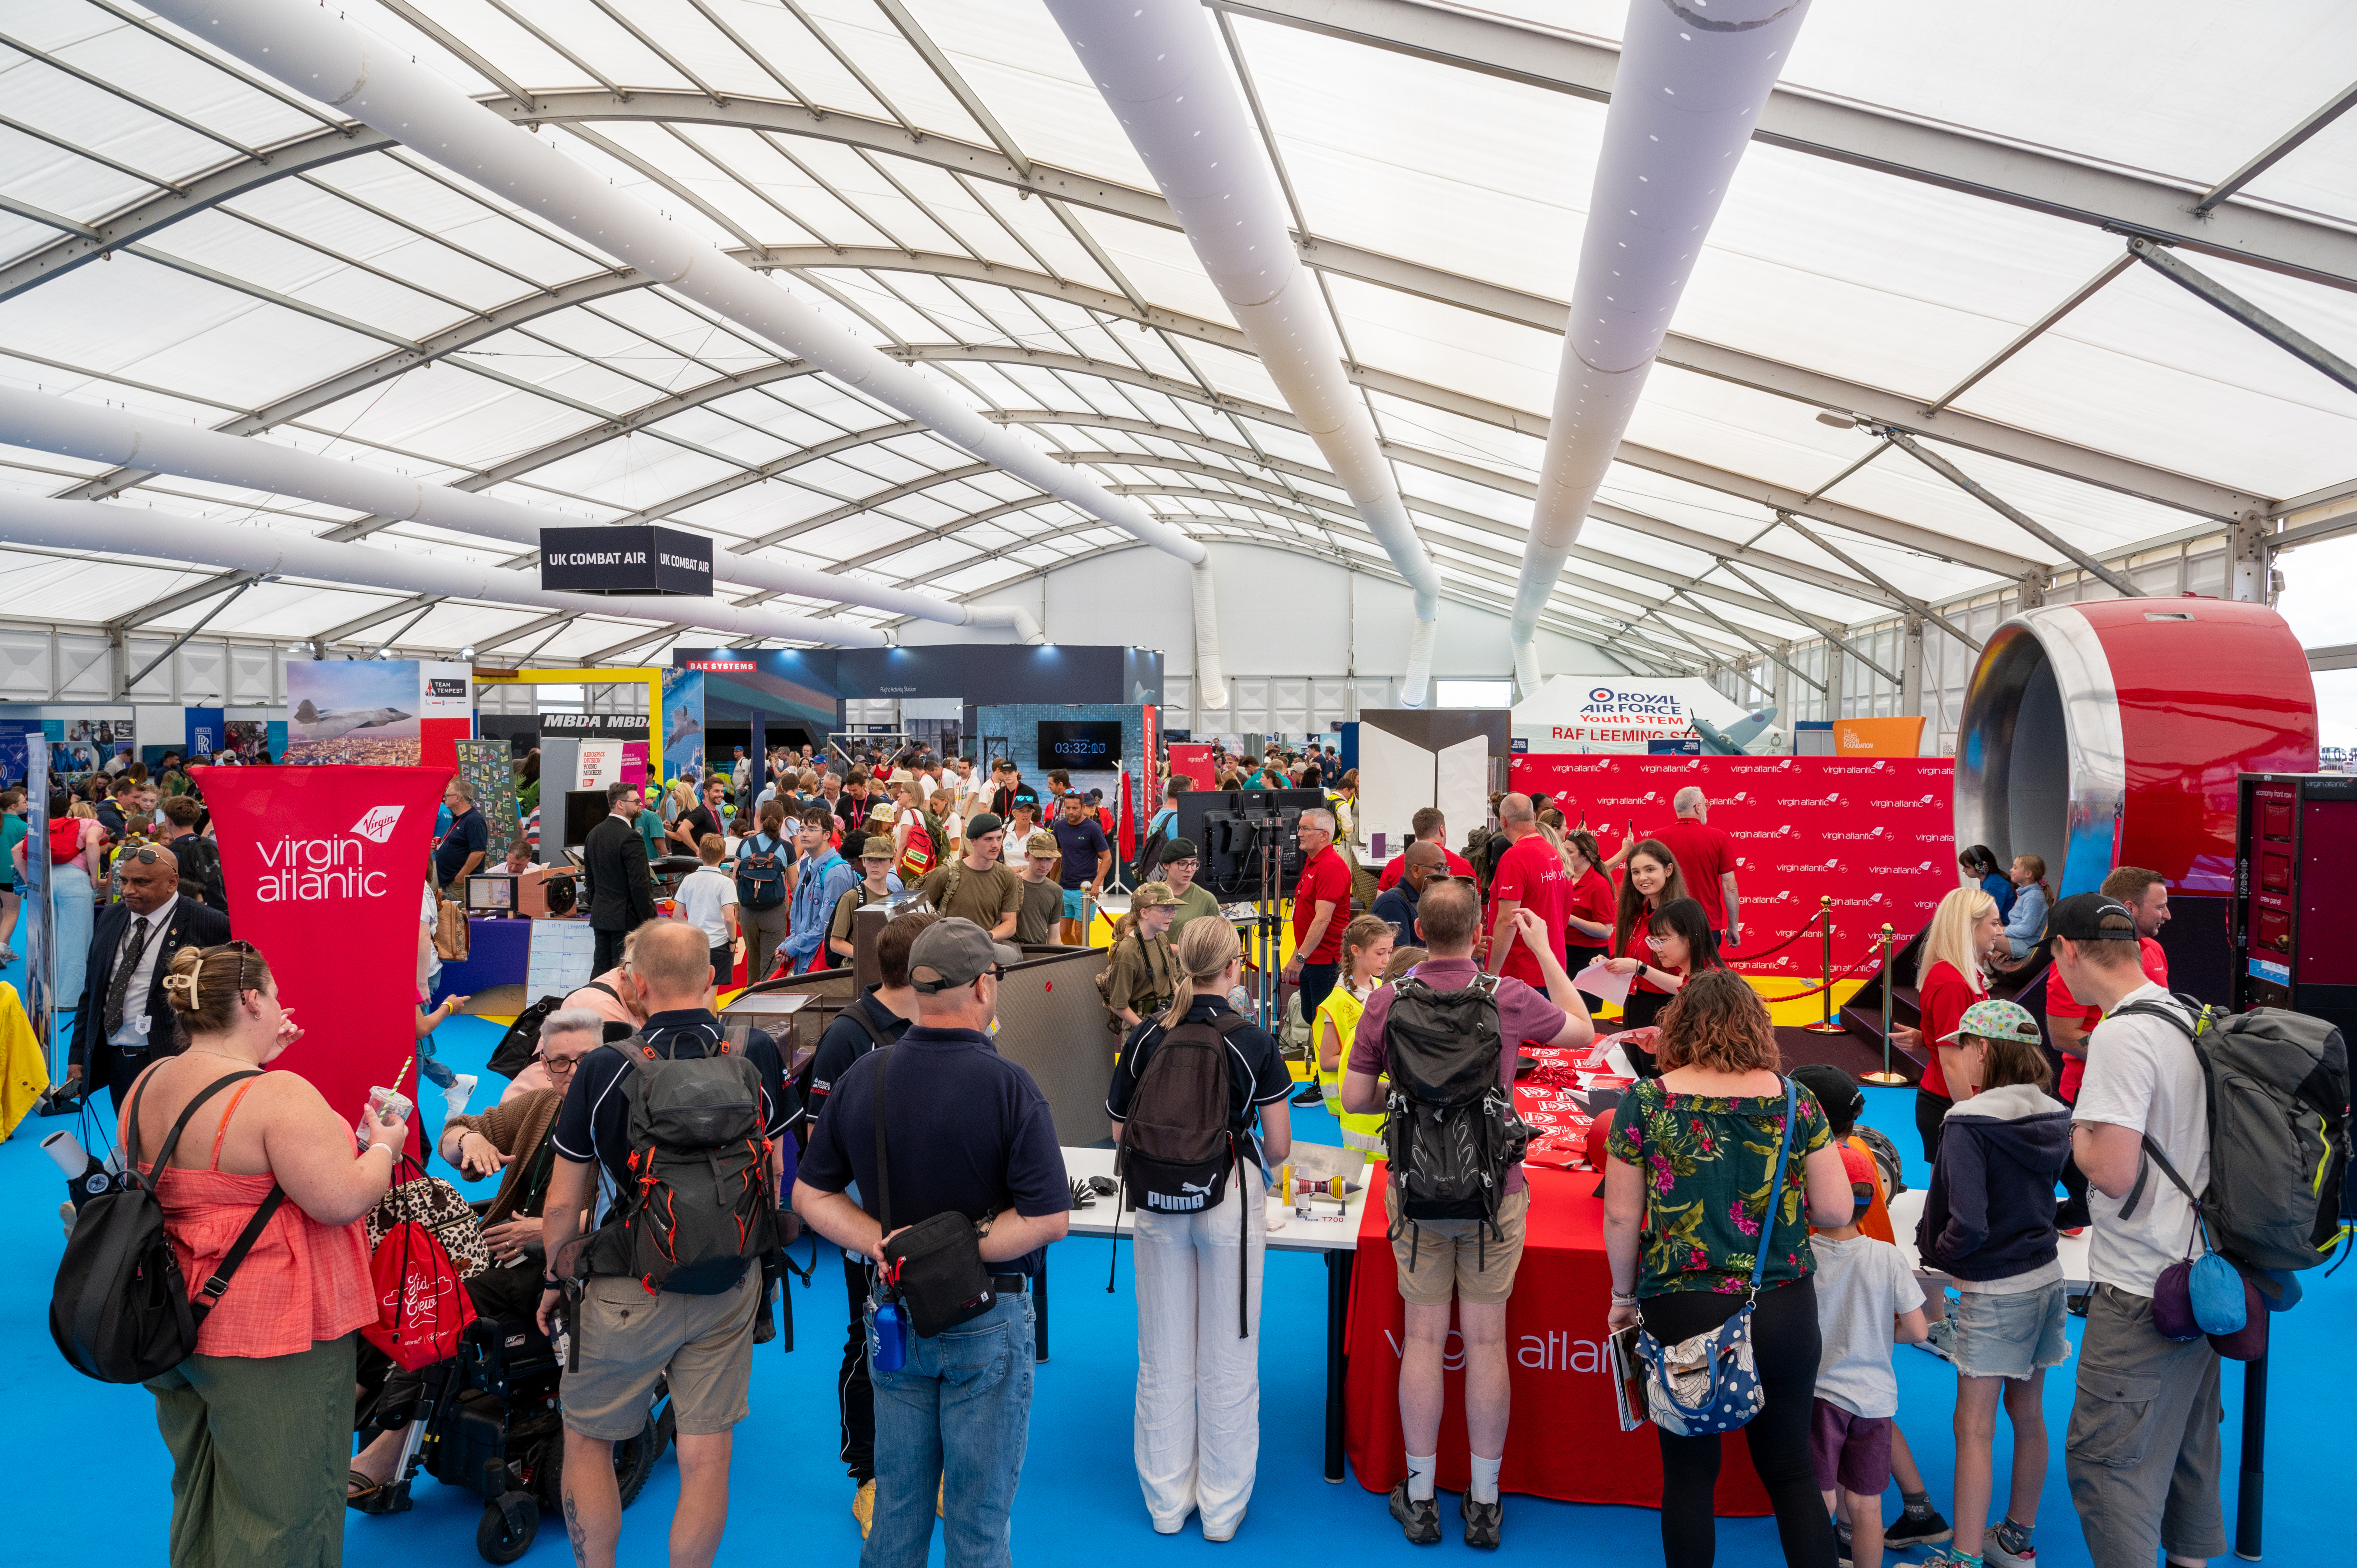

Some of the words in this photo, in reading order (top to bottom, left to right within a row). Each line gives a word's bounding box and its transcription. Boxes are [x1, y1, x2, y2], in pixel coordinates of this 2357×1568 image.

[549, 554, 567, 565] UK
[570, 553, 621, 565] COMBAT
[624, 552, 647, 564] AIR
[660, 553, 670, 566] UK
[671, 555, 698, 570] COMBAT
[698, 561, 709, 573] AIR
[1618, 693, 1680, 705] ROYAL
[1580, 704, 1615, 713] AIR
[1618, 703, 1682, 715] FORCE
[544, 715, 601, 727] MBDA
[1580, 714, 1630, 723] Youth
[1635, 715, 1684, 725] STEM
[1552, 727, 1585, 740] RAF
[1590, 729, 1664, 742] LEEMING
[1552, 765, 1573, 773] virgin
[1640, 765, 1662, 773] virgin
[1730, 765, 1753, 774] virgin
[1823, 766, 1845, 775] virgin
[1917, 767, 1940, 775] virgin
[1597, 797, 1618, 806] virgin
[1777, 798, 1800, 807] virgin
[1870, 799, 1893, 808] virgin
[363, 809, 396, 837] Virgin
[1730, 831, 1752, 839] virgin
[1822, 832, 1844, 841] virgin
[1915, 834, 1938, 842] virgin
[256, 834, 362, 872] virgin
[1776, 864, 1799, 872] virgin
[1869, 867, 1892, 875] virgin
[1541, 869, 1557, 883] Hello
[256, 867, 387, 902] atlantic
[1914, 901, 1937, 909] virgin
[1729, 962, 1750, 970] virgin
[1148, 1190, 1204, 1210] PUMA
[963, 1298, 980, 1309] OSPREY
